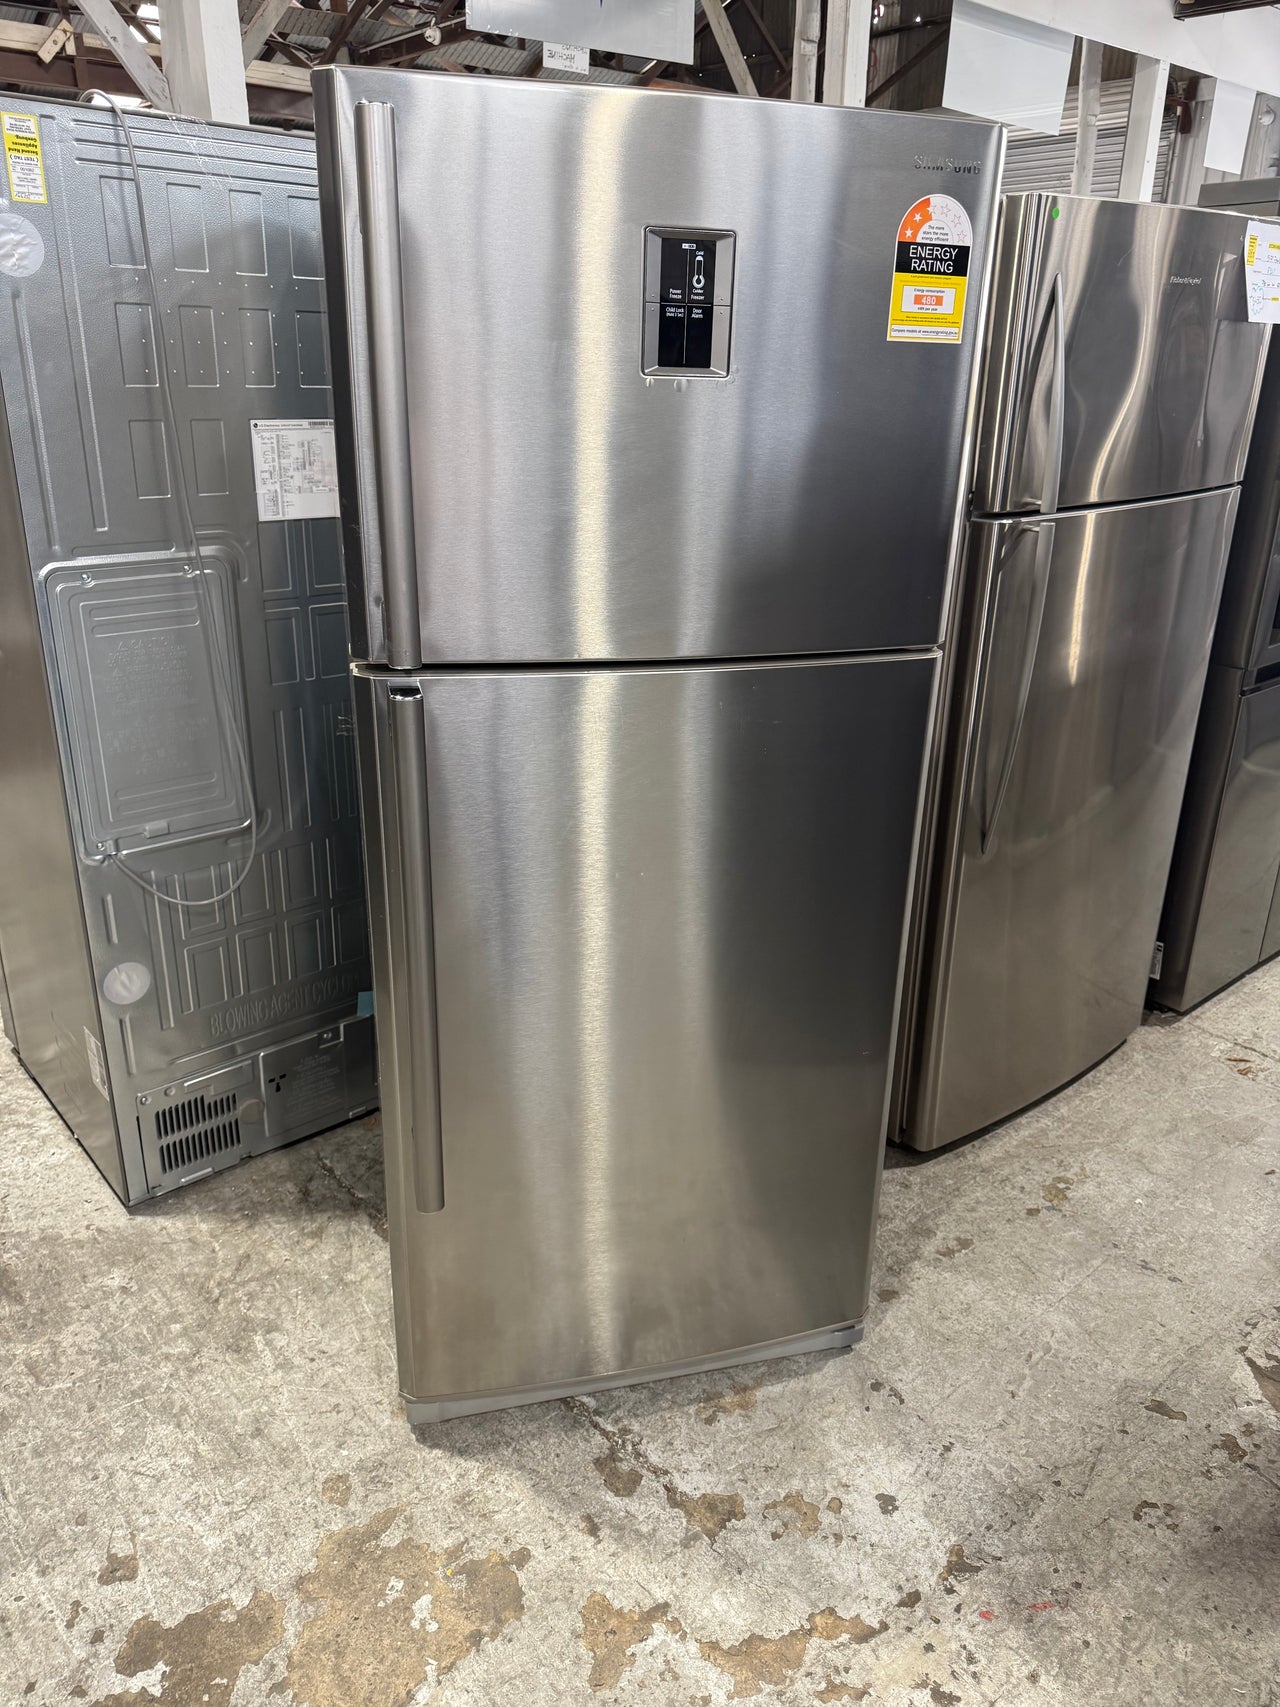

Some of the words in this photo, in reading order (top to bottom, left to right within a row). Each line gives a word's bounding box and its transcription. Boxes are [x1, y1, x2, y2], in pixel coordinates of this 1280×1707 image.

[914, 155, 982, 175] SAMSUNG
[910, 245, 958, 260] ENERGY
[911, 259, 953, 273] RATING
[922, 296, 936, 305] 480
[210, 1000, 268, 1037] BLOWING
[270, 986, 309, 1018] AGENT
